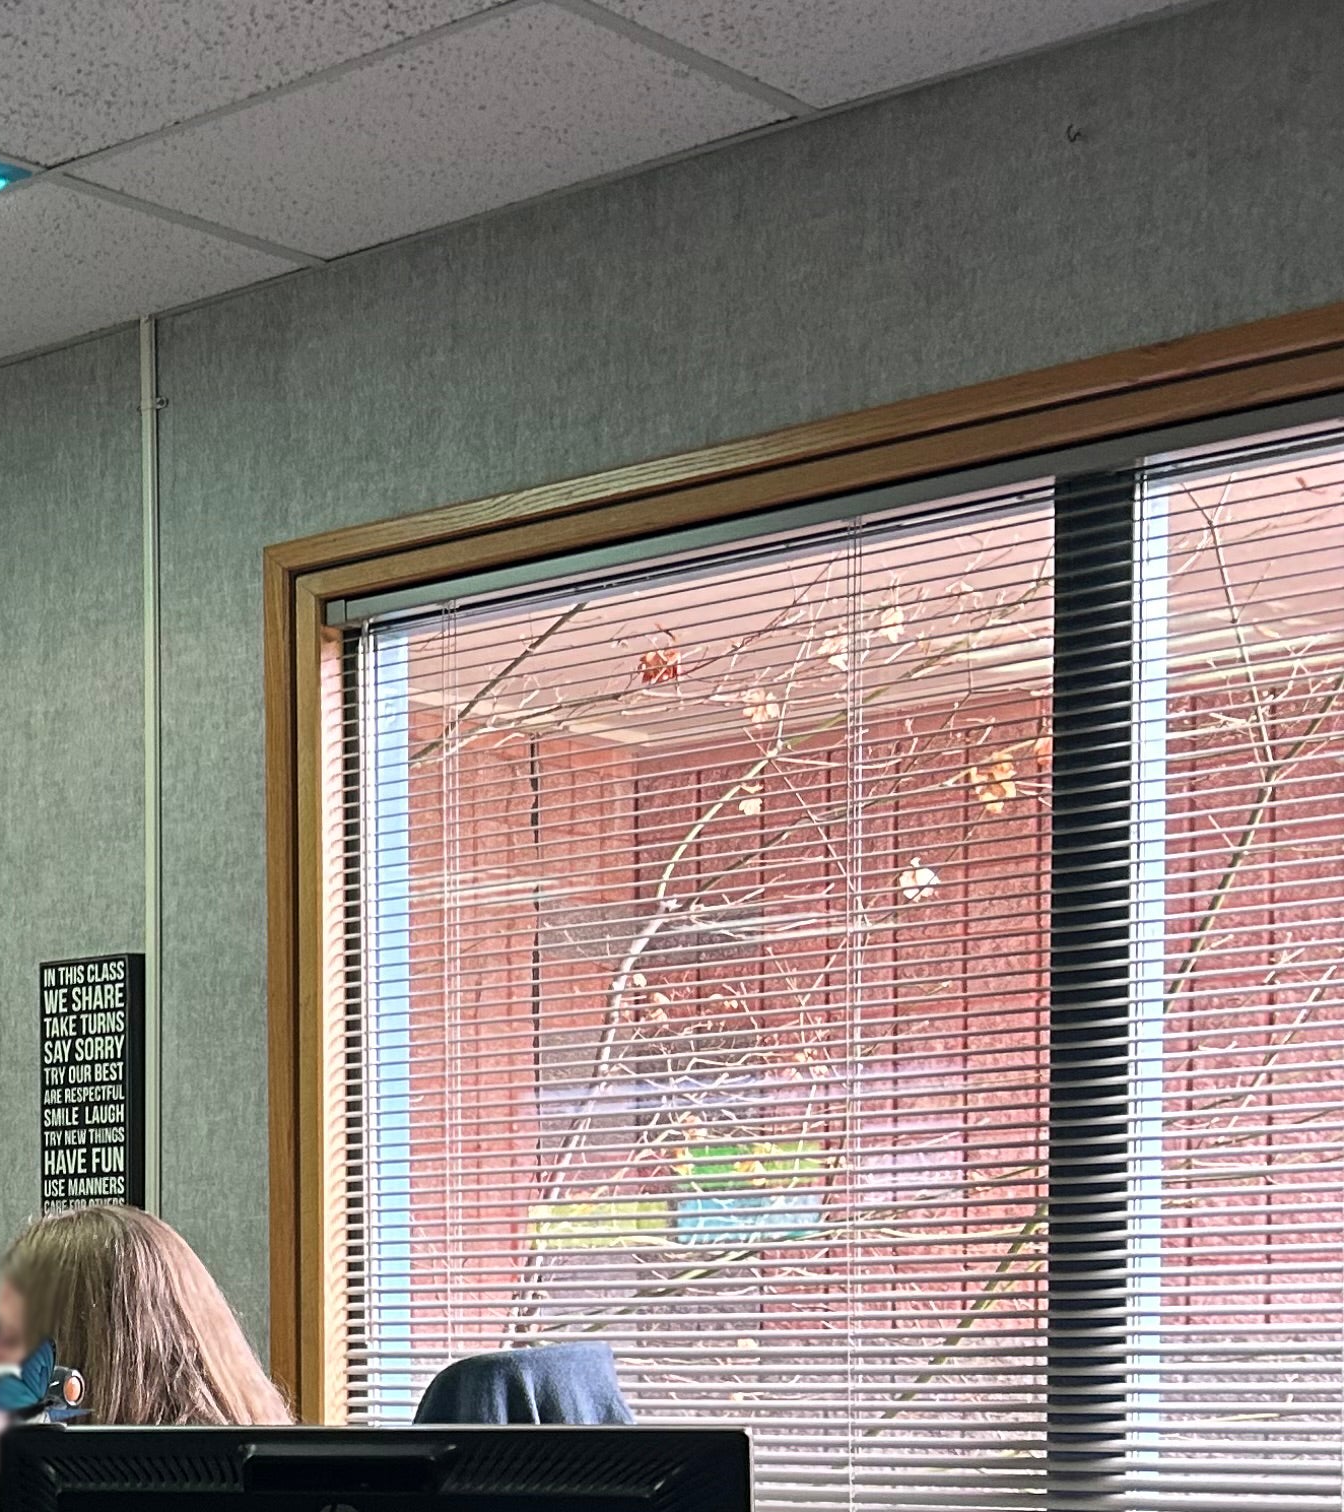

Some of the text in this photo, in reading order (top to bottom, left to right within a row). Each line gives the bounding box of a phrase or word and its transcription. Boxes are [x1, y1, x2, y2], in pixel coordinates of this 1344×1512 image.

[44, 961, 124, 987] IN THIS CLASS
[44, 983, 124, 1014] WE SHARE
[44, 1012, 124, 1038] TAKE TURNS
[44, 1035, 124, 1064] SAY SORRY
[44, 1062, 123, 1085] TRY OUR BEST
[44, 1084, 124, 1104] ARE RESPECTFUL
[44, 1104, 124, 1127] SMILE LAUGH
[44, 1126, 124, 1146] TRY NEW THINGS
[44, 1147, 124, 1175] HAVE FUN
[44, 1176, 124, 1197] USE MANNERS
